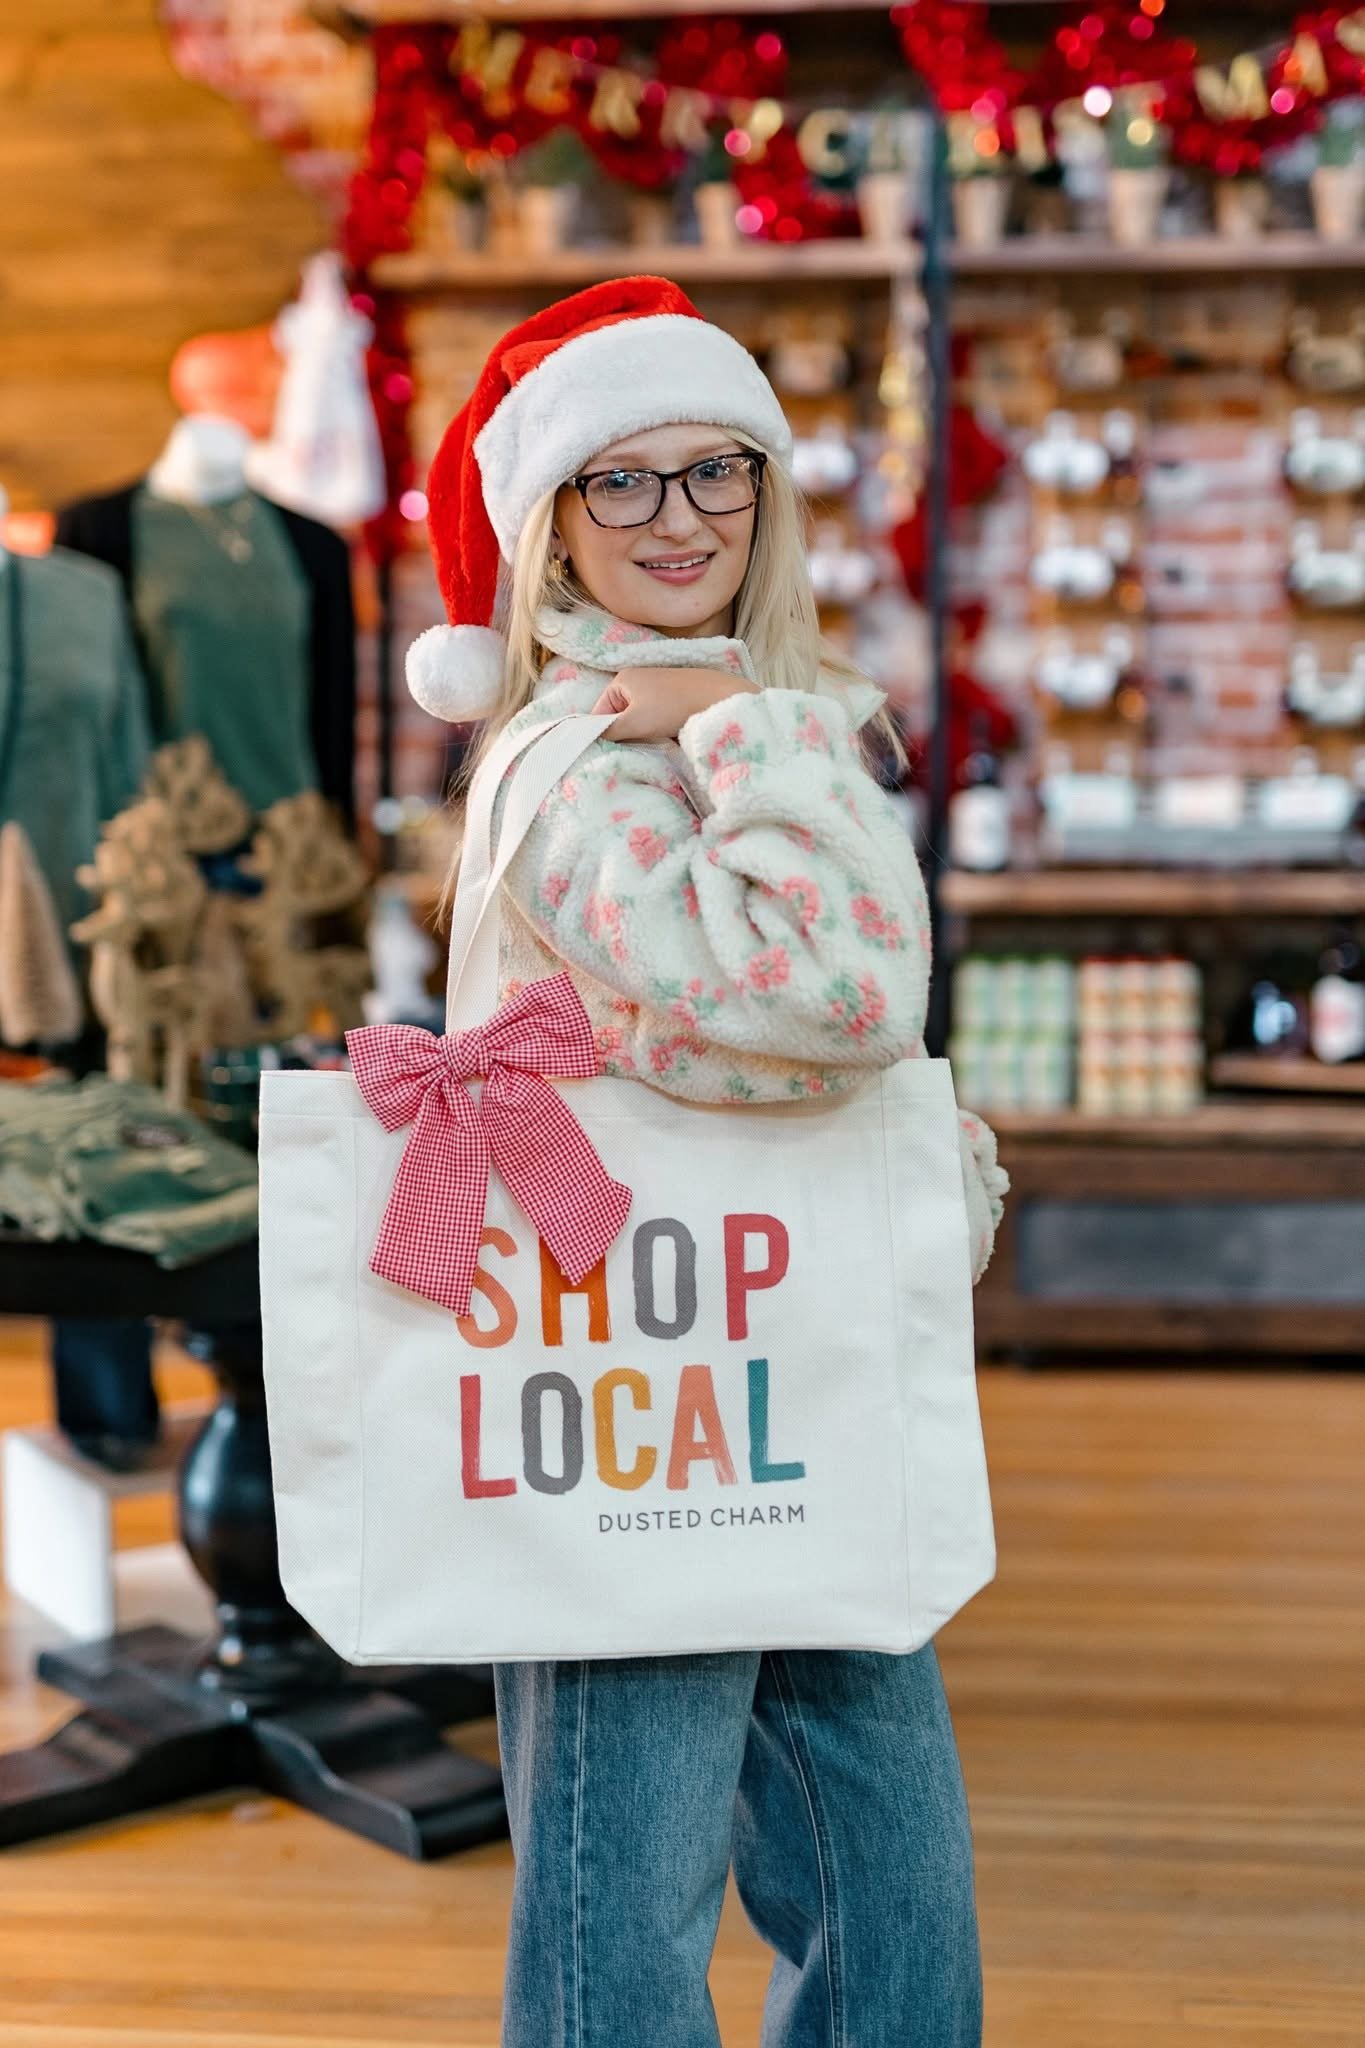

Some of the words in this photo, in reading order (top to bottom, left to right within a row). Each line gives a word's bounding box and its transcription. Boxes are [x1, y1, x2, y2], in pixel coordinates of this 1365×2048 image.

[456, 1213, 790, 1348] SHOP
[459, 1358, 806, 1499] LOCAL
[599, 1509, 701, 1533] DUSTED
[709, 1503, 805, 1527] CHARM
